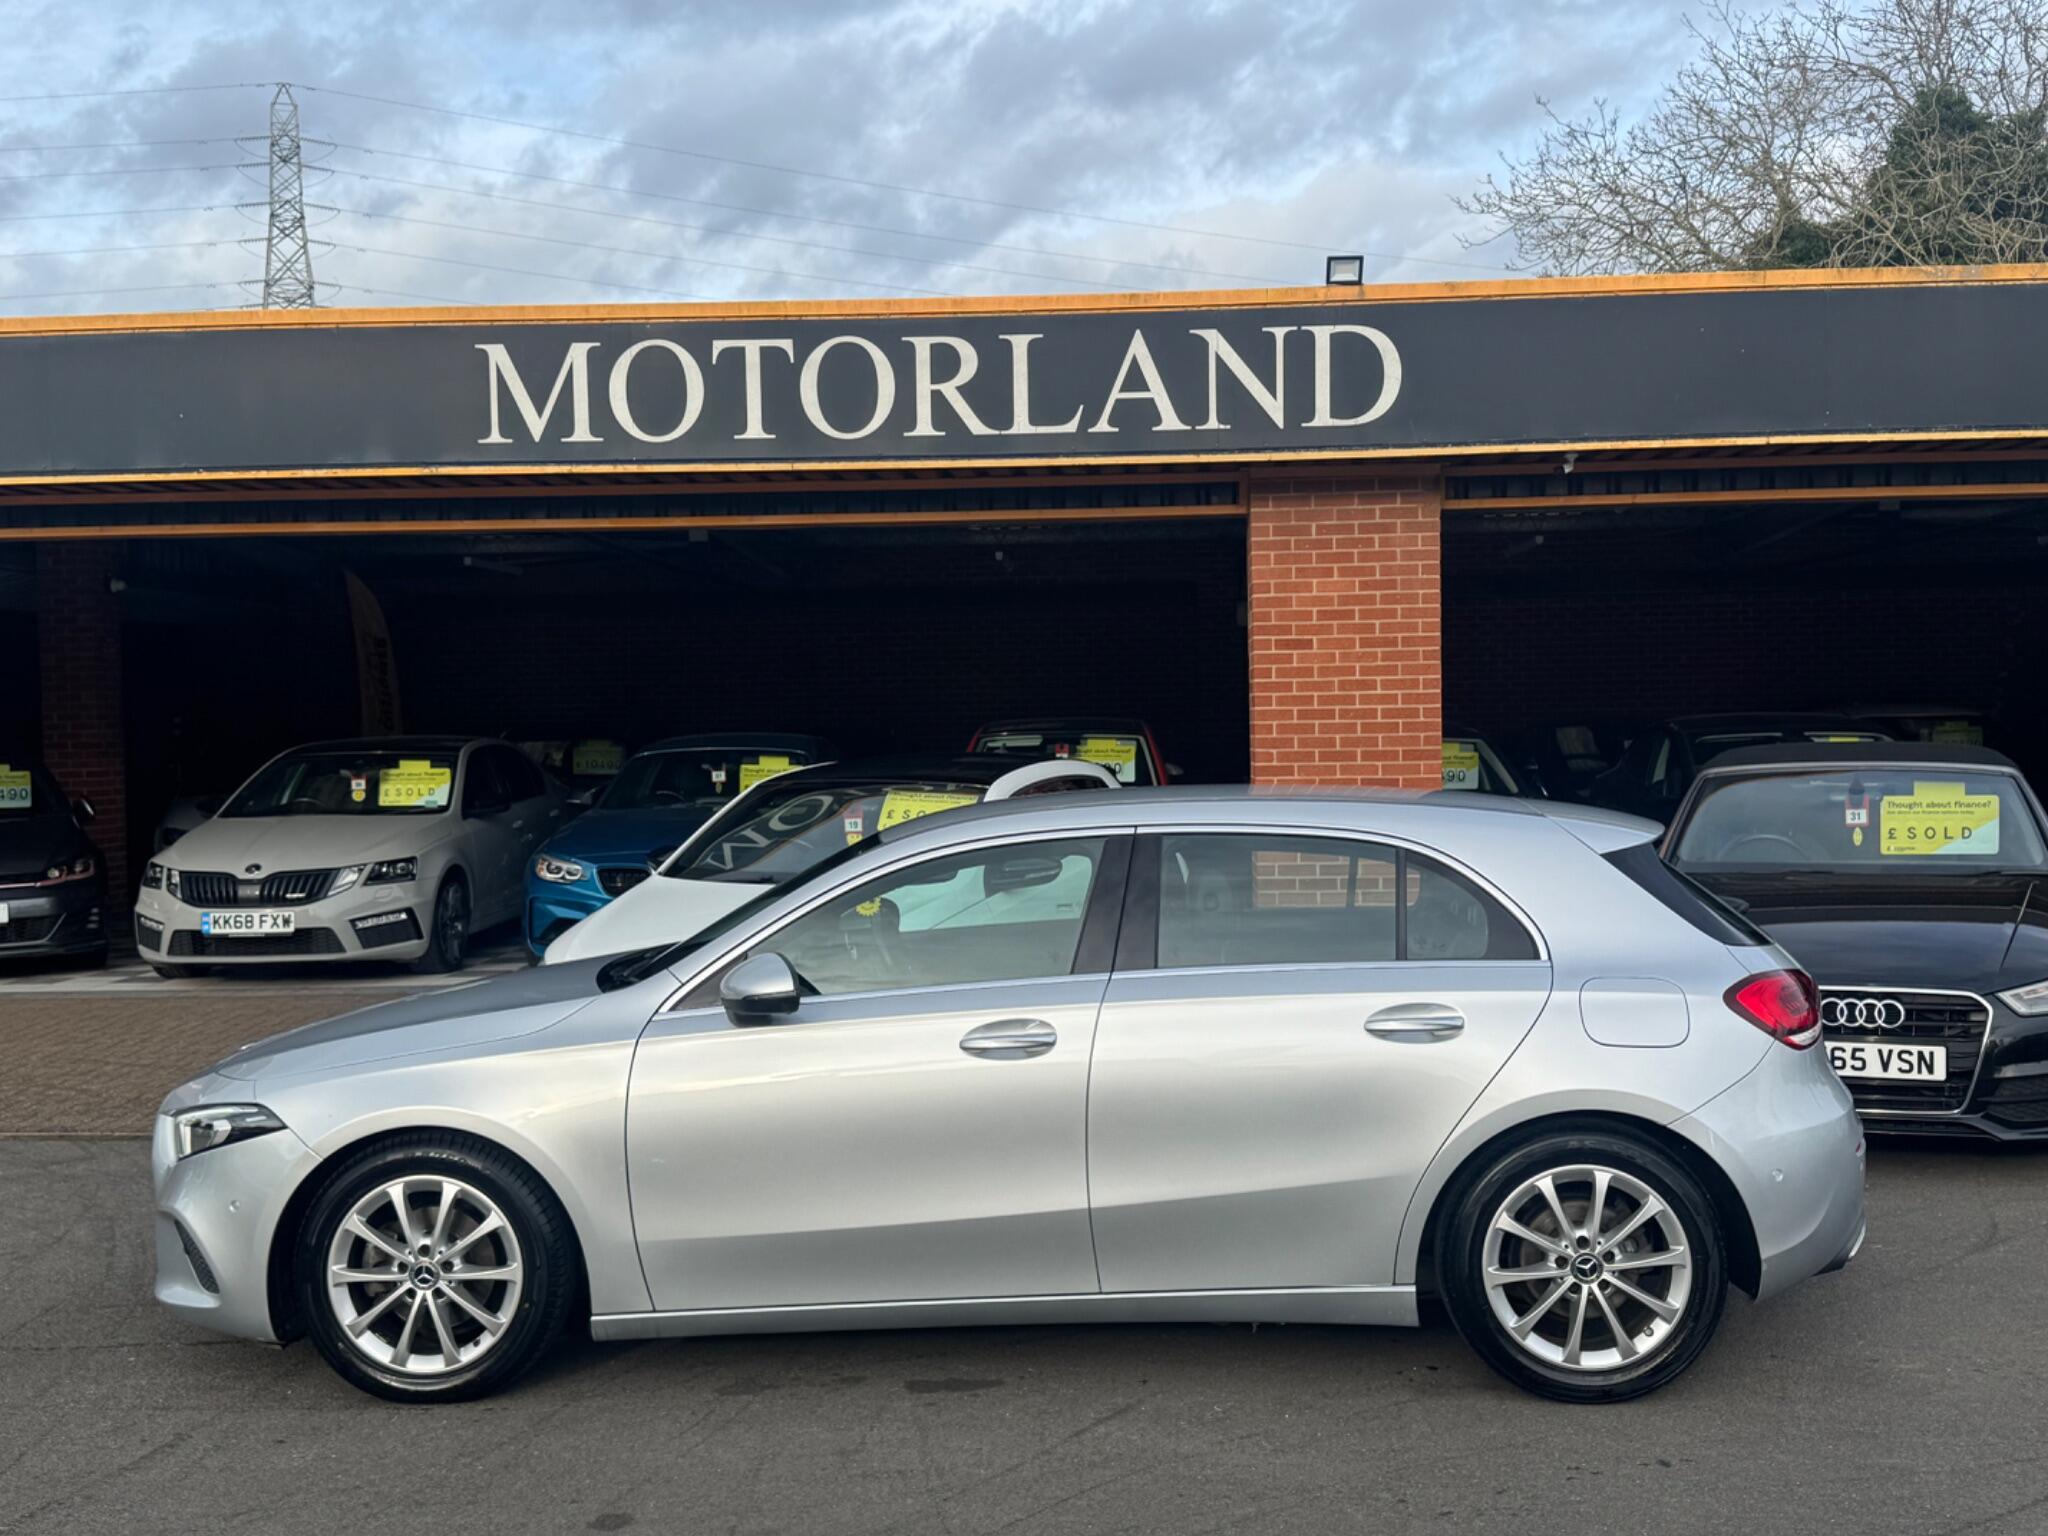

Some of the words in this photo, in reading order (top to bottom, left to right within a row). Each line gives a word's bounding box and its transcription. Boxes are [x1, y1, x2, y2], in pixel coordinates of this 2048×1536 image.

[474, 323, 1403, 444] MOTORLAND
[1442, 770, 1466, 782] 90
[396, 787, 436, 797] SOLD
[1886, 800, 1923, 810] Thought
[1925, 801, 1952, 809] about
[1907, 827, 1973, 840] SOLD
[212, 914, 254, 929] KK68
[259, 914, 293, 929] FXW
[1877, 1048, 1935, 1076] VSN
